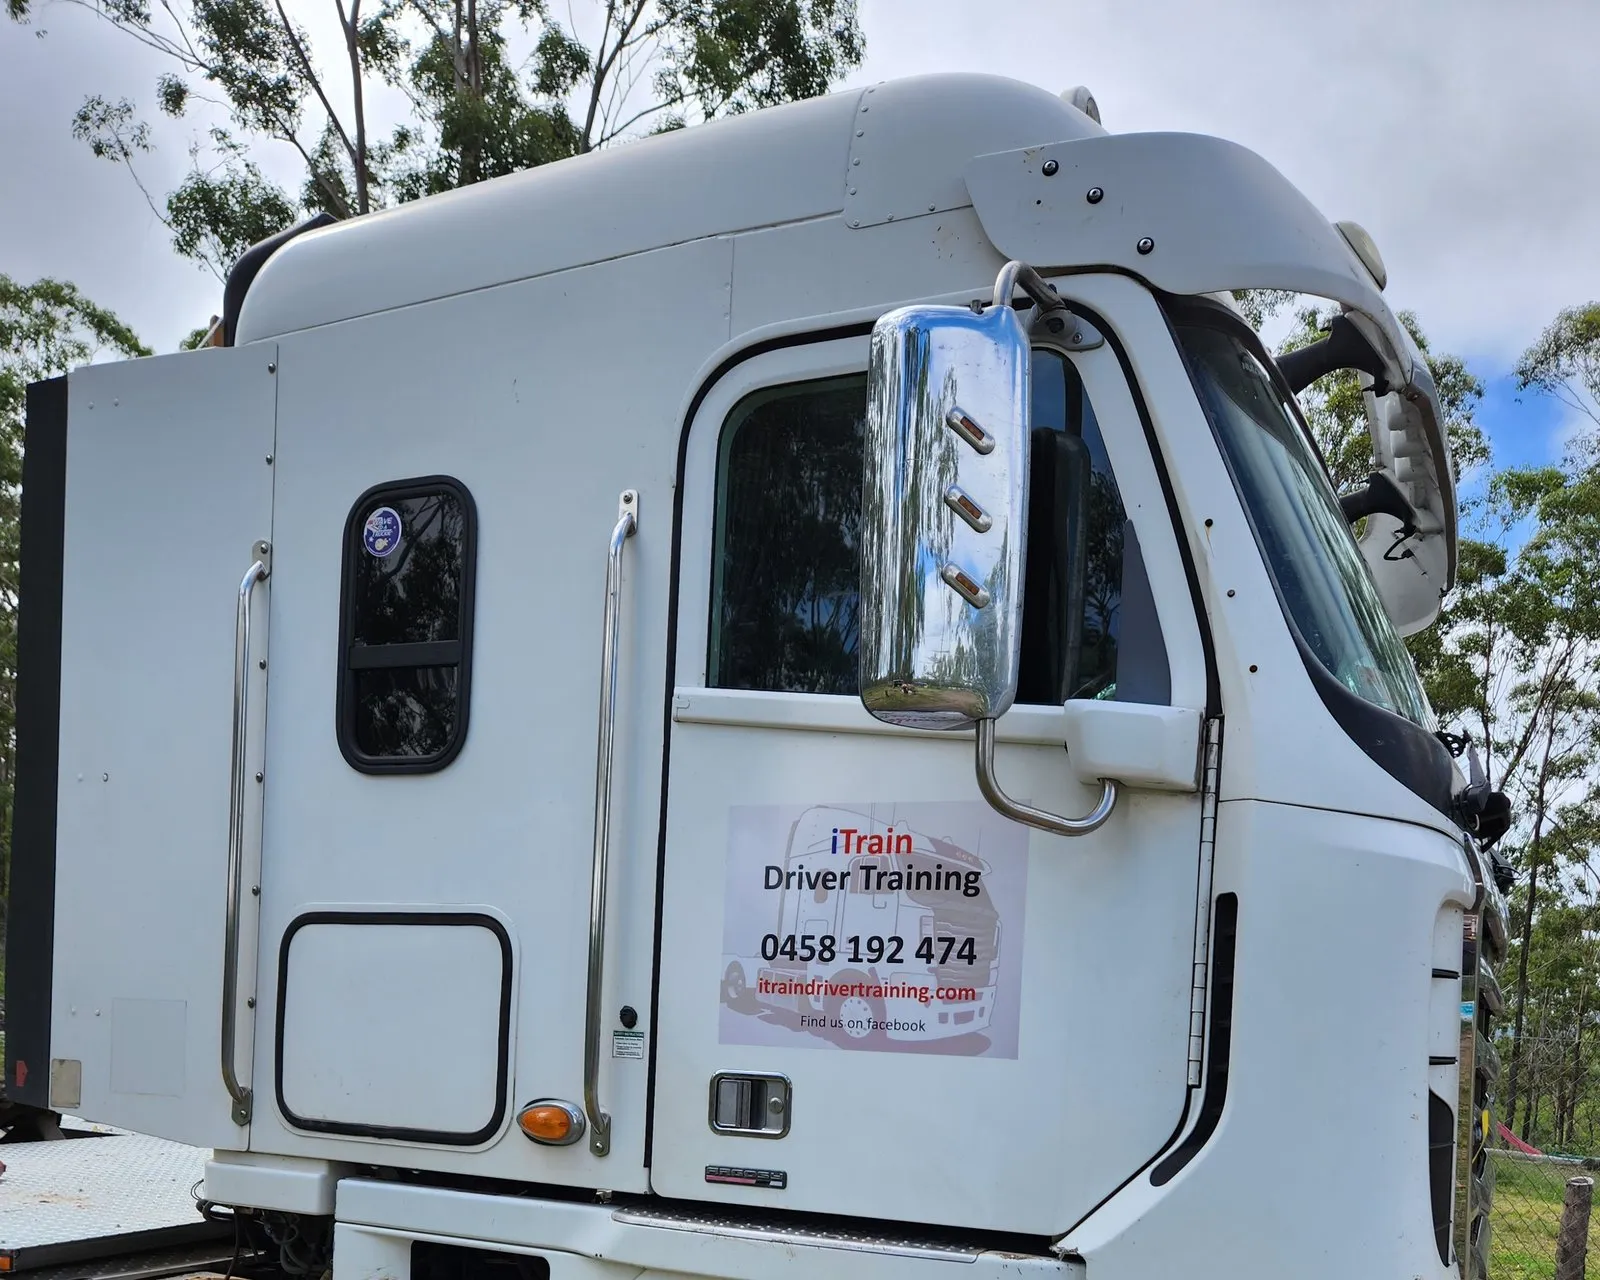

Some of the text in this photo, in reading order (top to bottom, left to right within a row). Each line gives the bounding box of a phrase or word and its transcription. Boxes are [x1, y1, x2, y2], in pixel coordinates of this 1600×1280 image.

[831, 827, 913, 855] iTrain
[763, 864, 982, 898] Driver Training
[760, 933, 977, 965] 0458 192 474
[758, 978, 976, 1003] itraindrivertraining.com
[800, 1015, 926, 1032] Find us on facebook
[706, 1167, 783, 1180] ARGOSY
